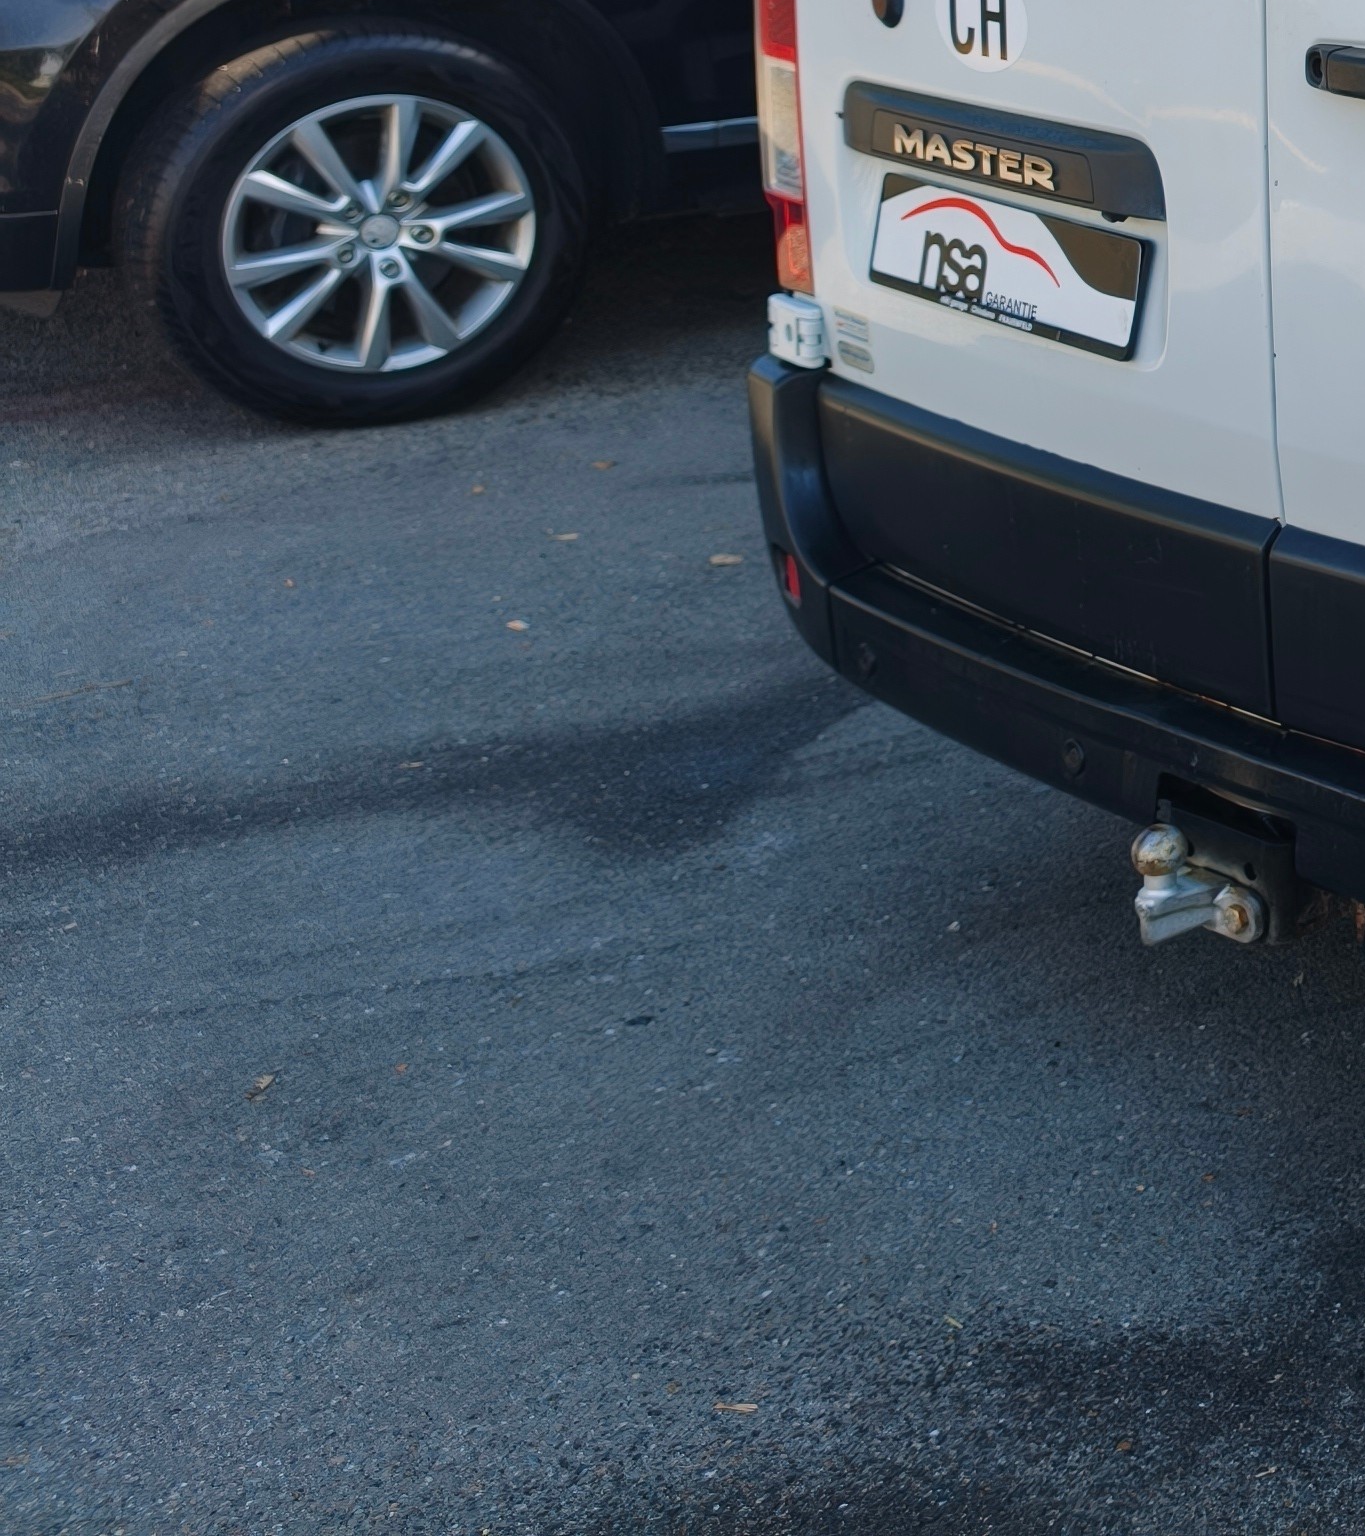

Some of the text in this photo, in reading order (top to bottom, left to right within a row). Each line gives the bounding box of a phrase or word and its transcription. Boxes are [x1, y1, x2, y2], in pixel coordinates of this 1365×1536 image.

[893, 122, 1056, 192] MASTER
[919, 230, 988, 305] nsa
[985, 291, 1038, 321] GARANTIE
